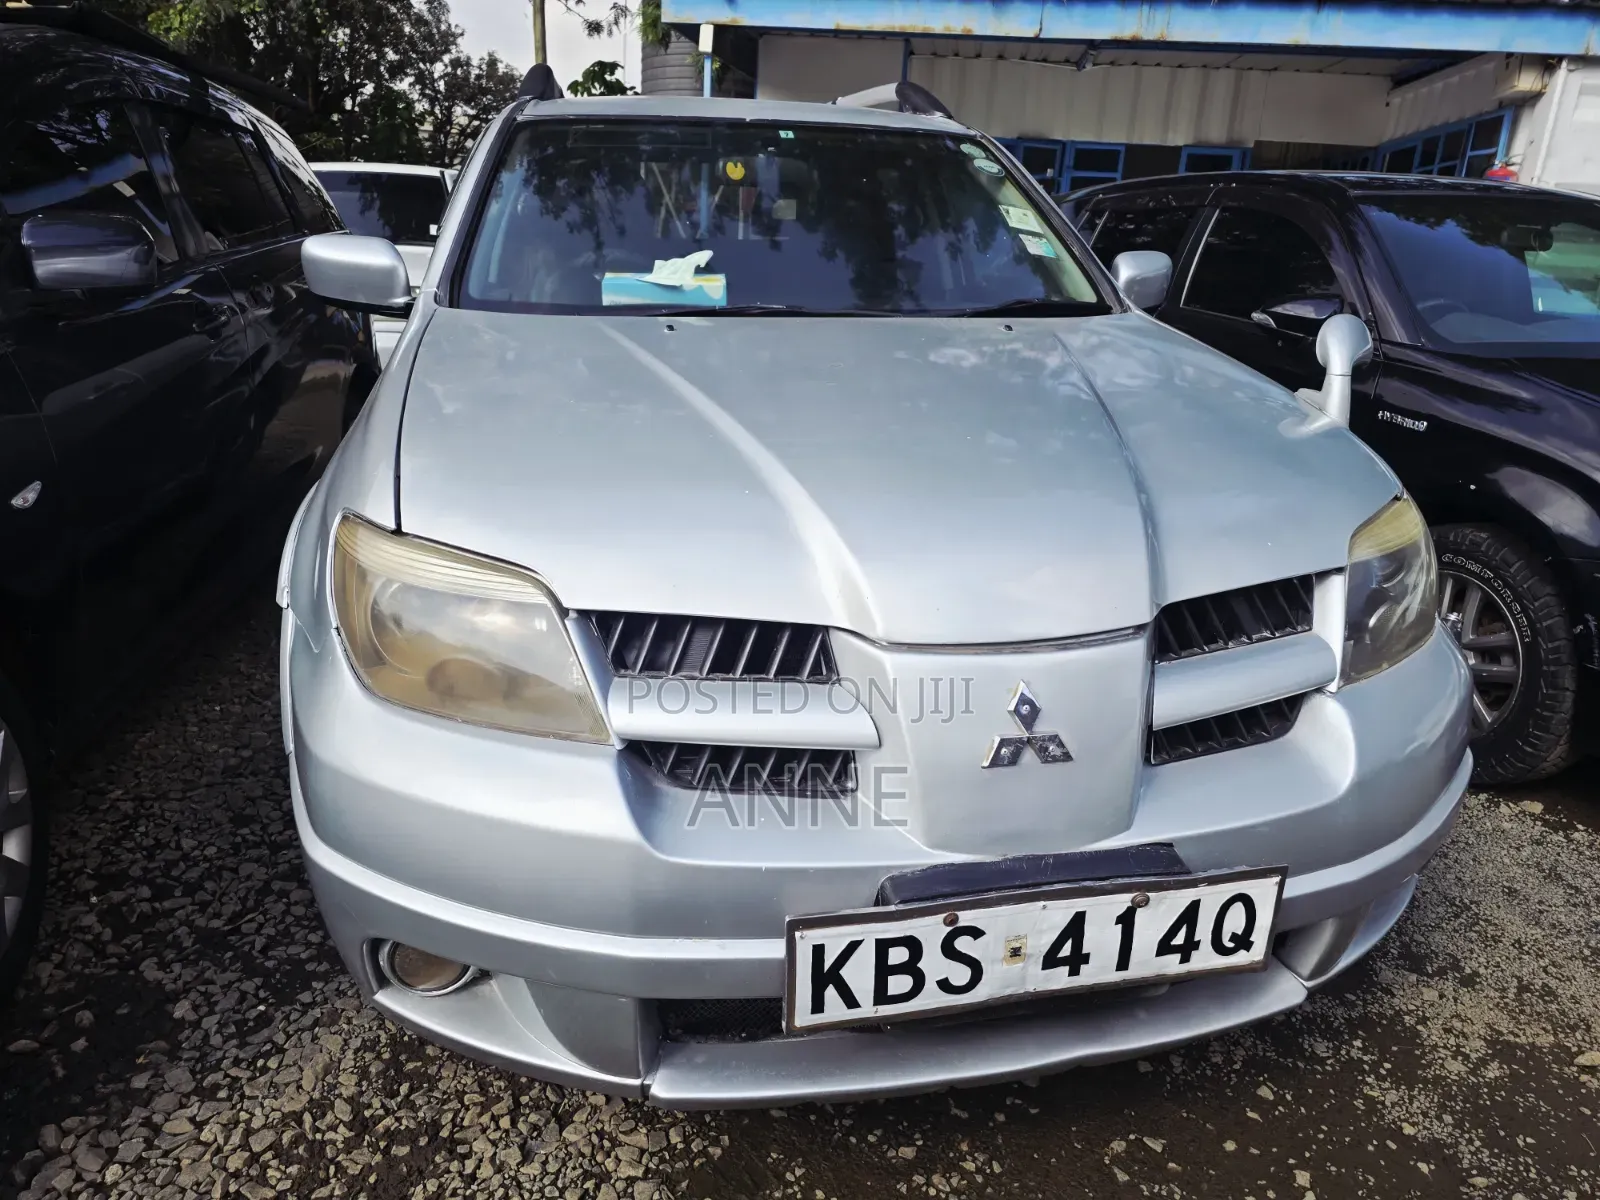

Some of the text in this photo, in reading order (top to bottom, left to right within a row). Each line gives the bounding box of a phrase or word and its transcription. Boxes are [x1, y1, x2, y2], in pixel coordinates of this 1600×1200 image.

[1442, 554, 1531, 642] COMFORSER
[811, 893, 1257, 1014] KBS 414Q
